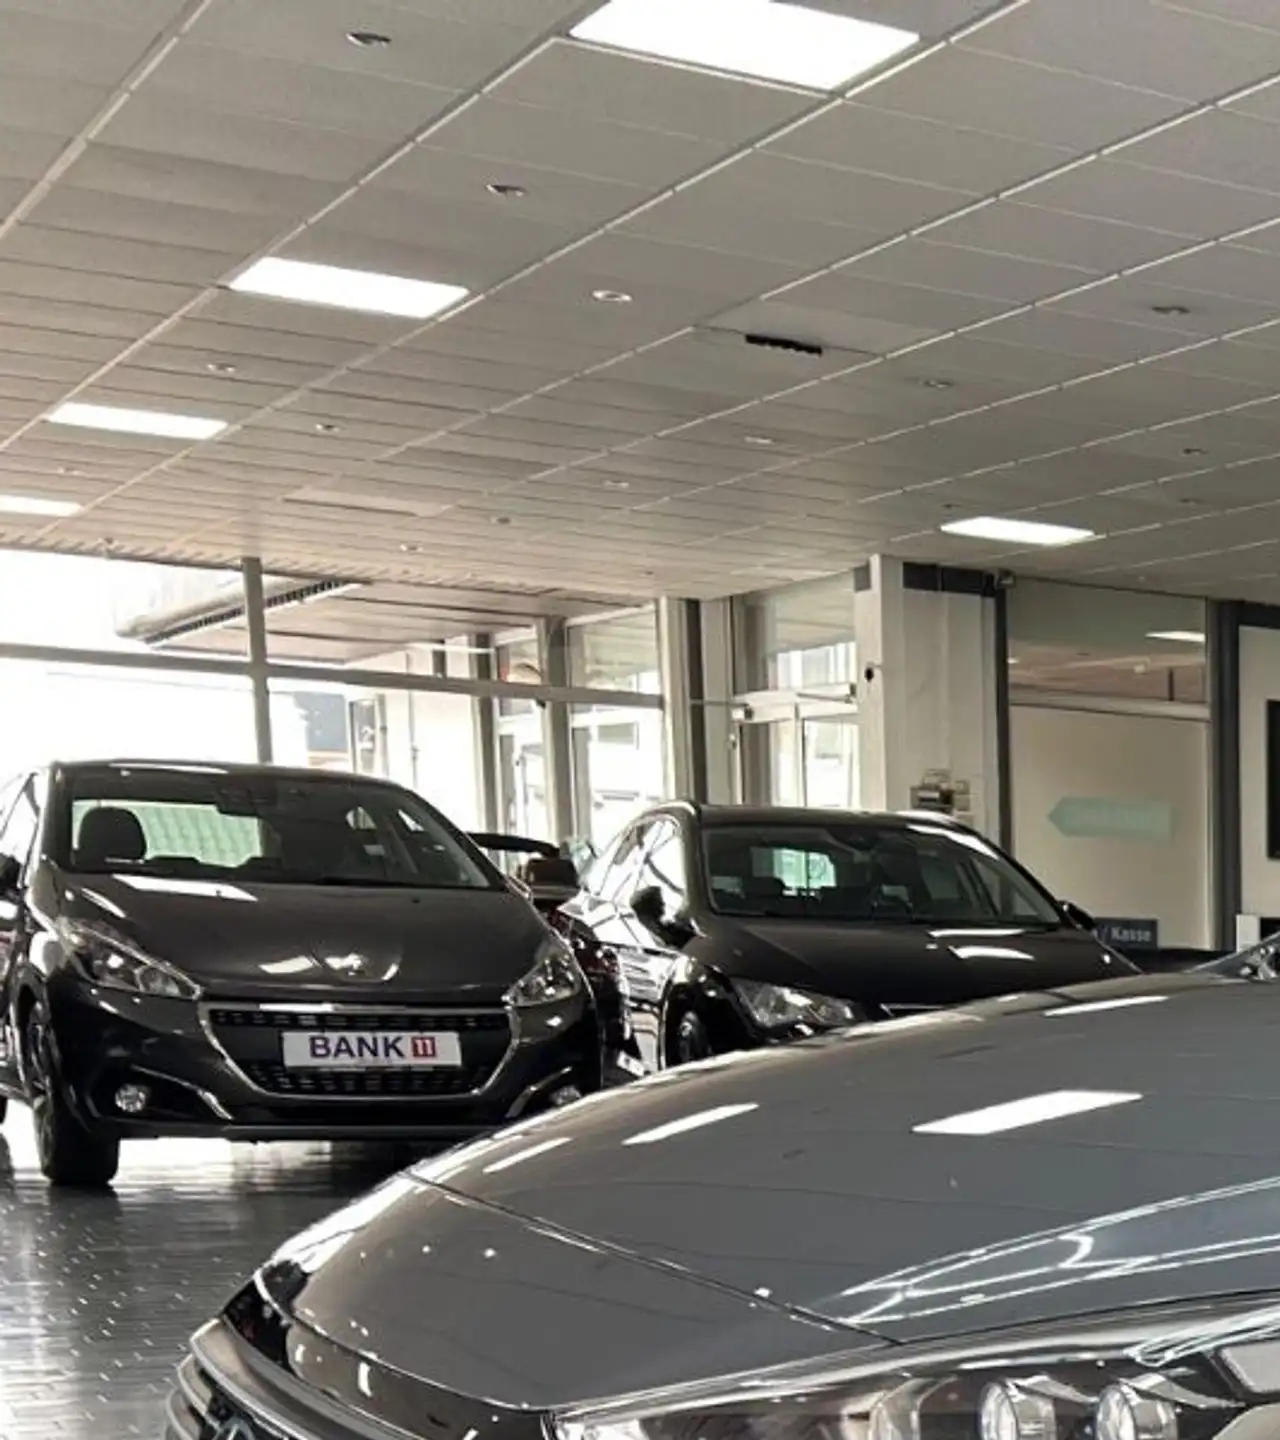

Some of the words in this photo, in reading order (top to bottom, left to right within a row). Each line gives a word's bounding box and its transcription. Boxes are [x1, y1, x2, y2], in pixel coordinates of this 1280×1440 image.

[1111, 926, 1151, 943] Kasse
[310, 1036, 405, 1059] BANK
[413, 1037, 436, 1058] 11
